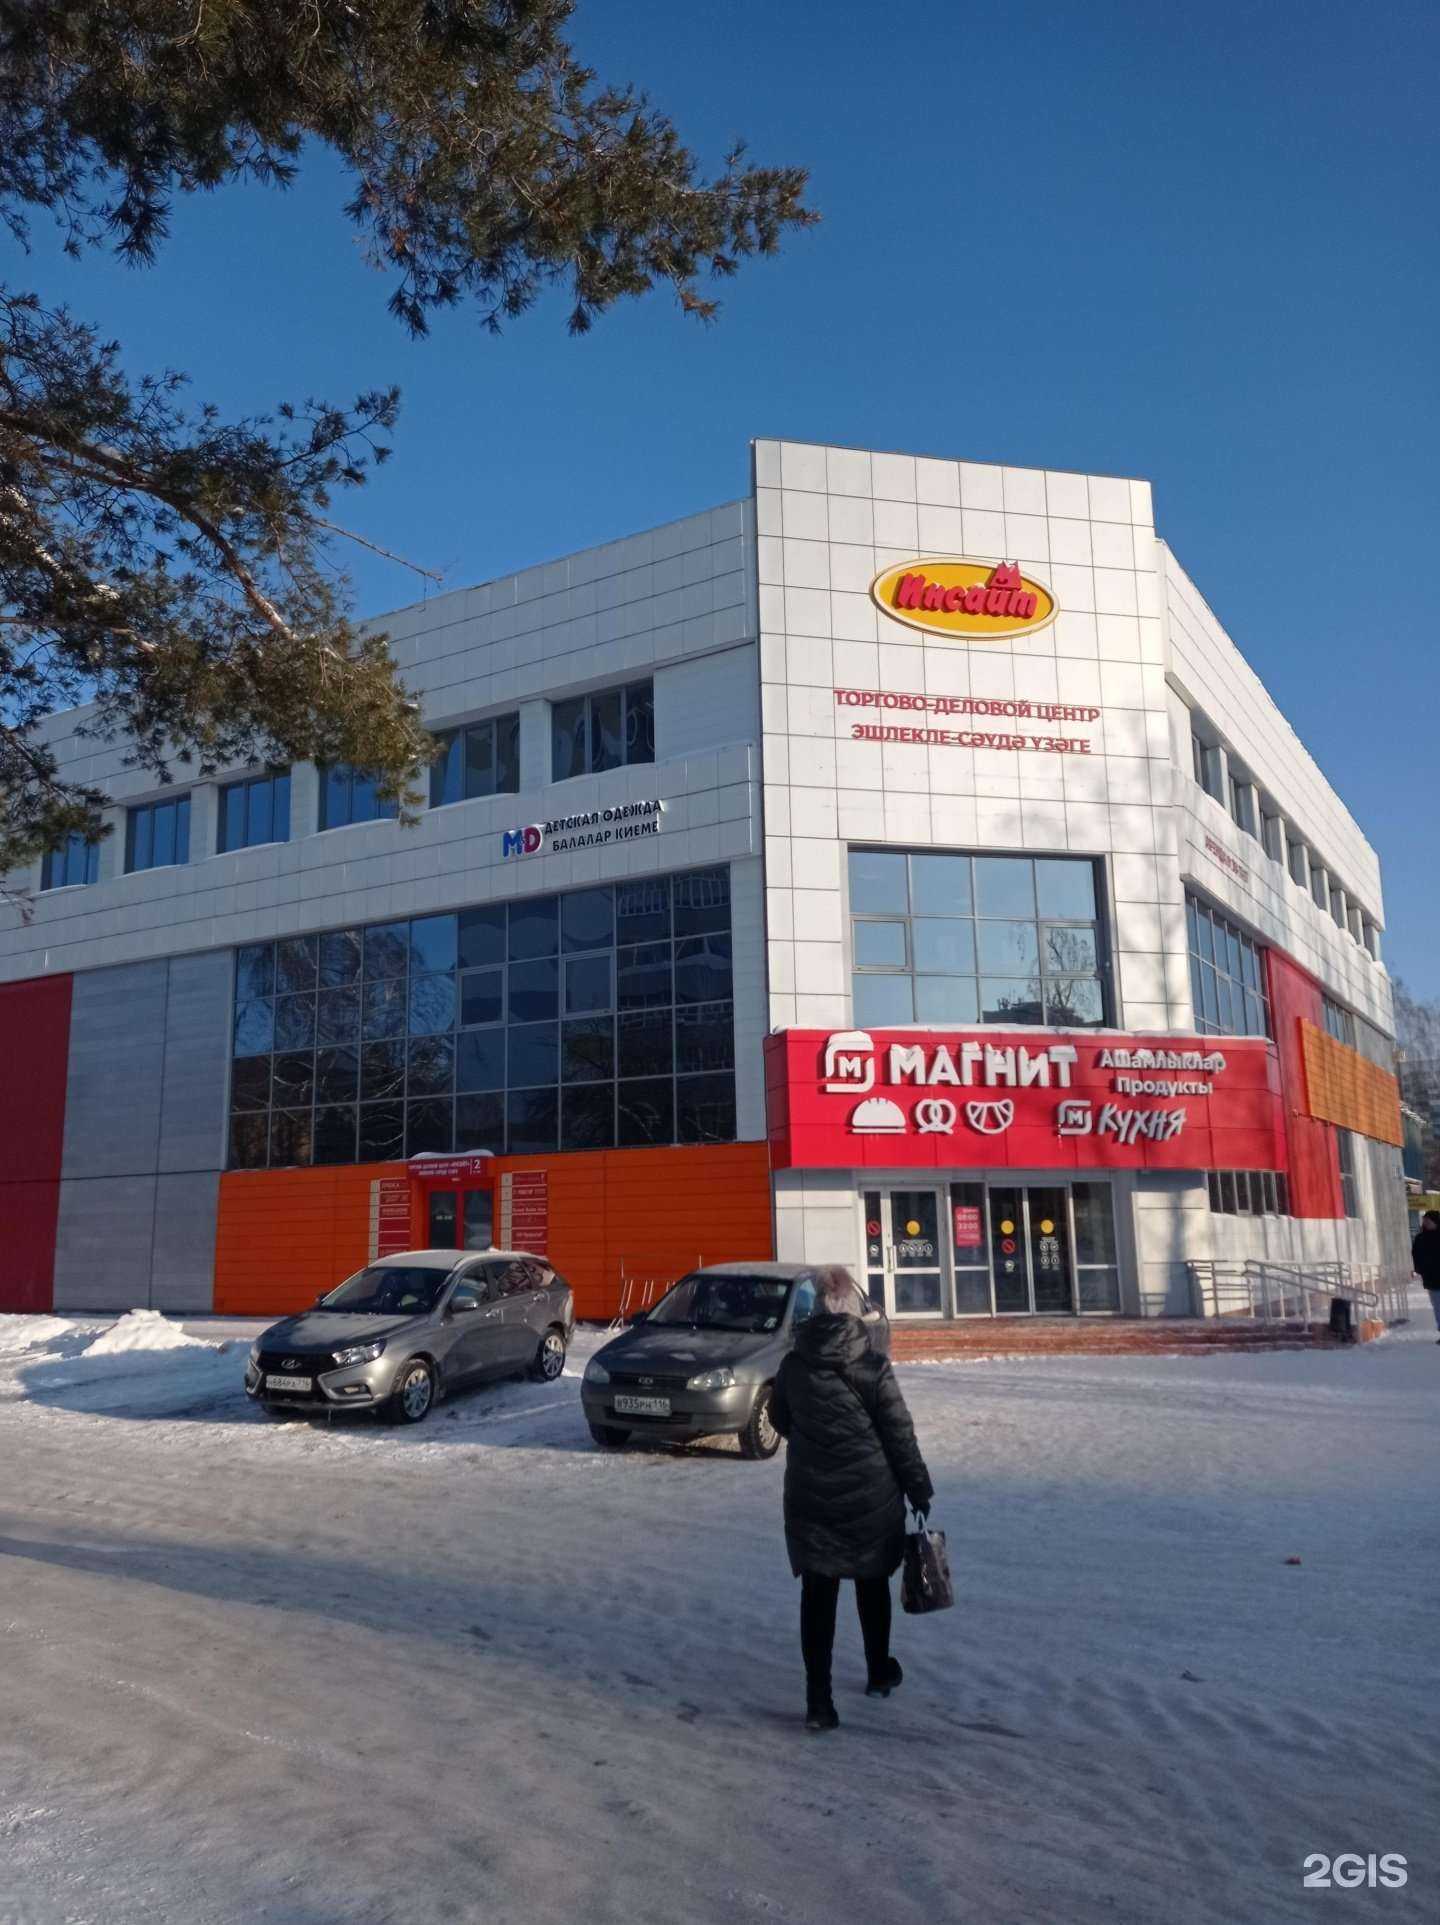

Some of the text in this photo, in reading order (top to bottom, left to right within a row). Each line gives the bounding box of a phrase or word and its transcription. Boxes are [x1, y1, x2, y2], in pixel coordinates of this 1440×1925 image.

[833, 689, 1100, 722] ТОРГОВО-ДЕЛОВОЙ ЦЕНТР
[545, 800, 662, 834] ДЕТСКАЯ ОДЕЖДА
[553, 810, 658, 851] БАЛАЛАР КИЕМЕ
[890, 1041, 1078, 1087] МАГНИТ
[1117, 1076, 1214, 1097] Продукты
